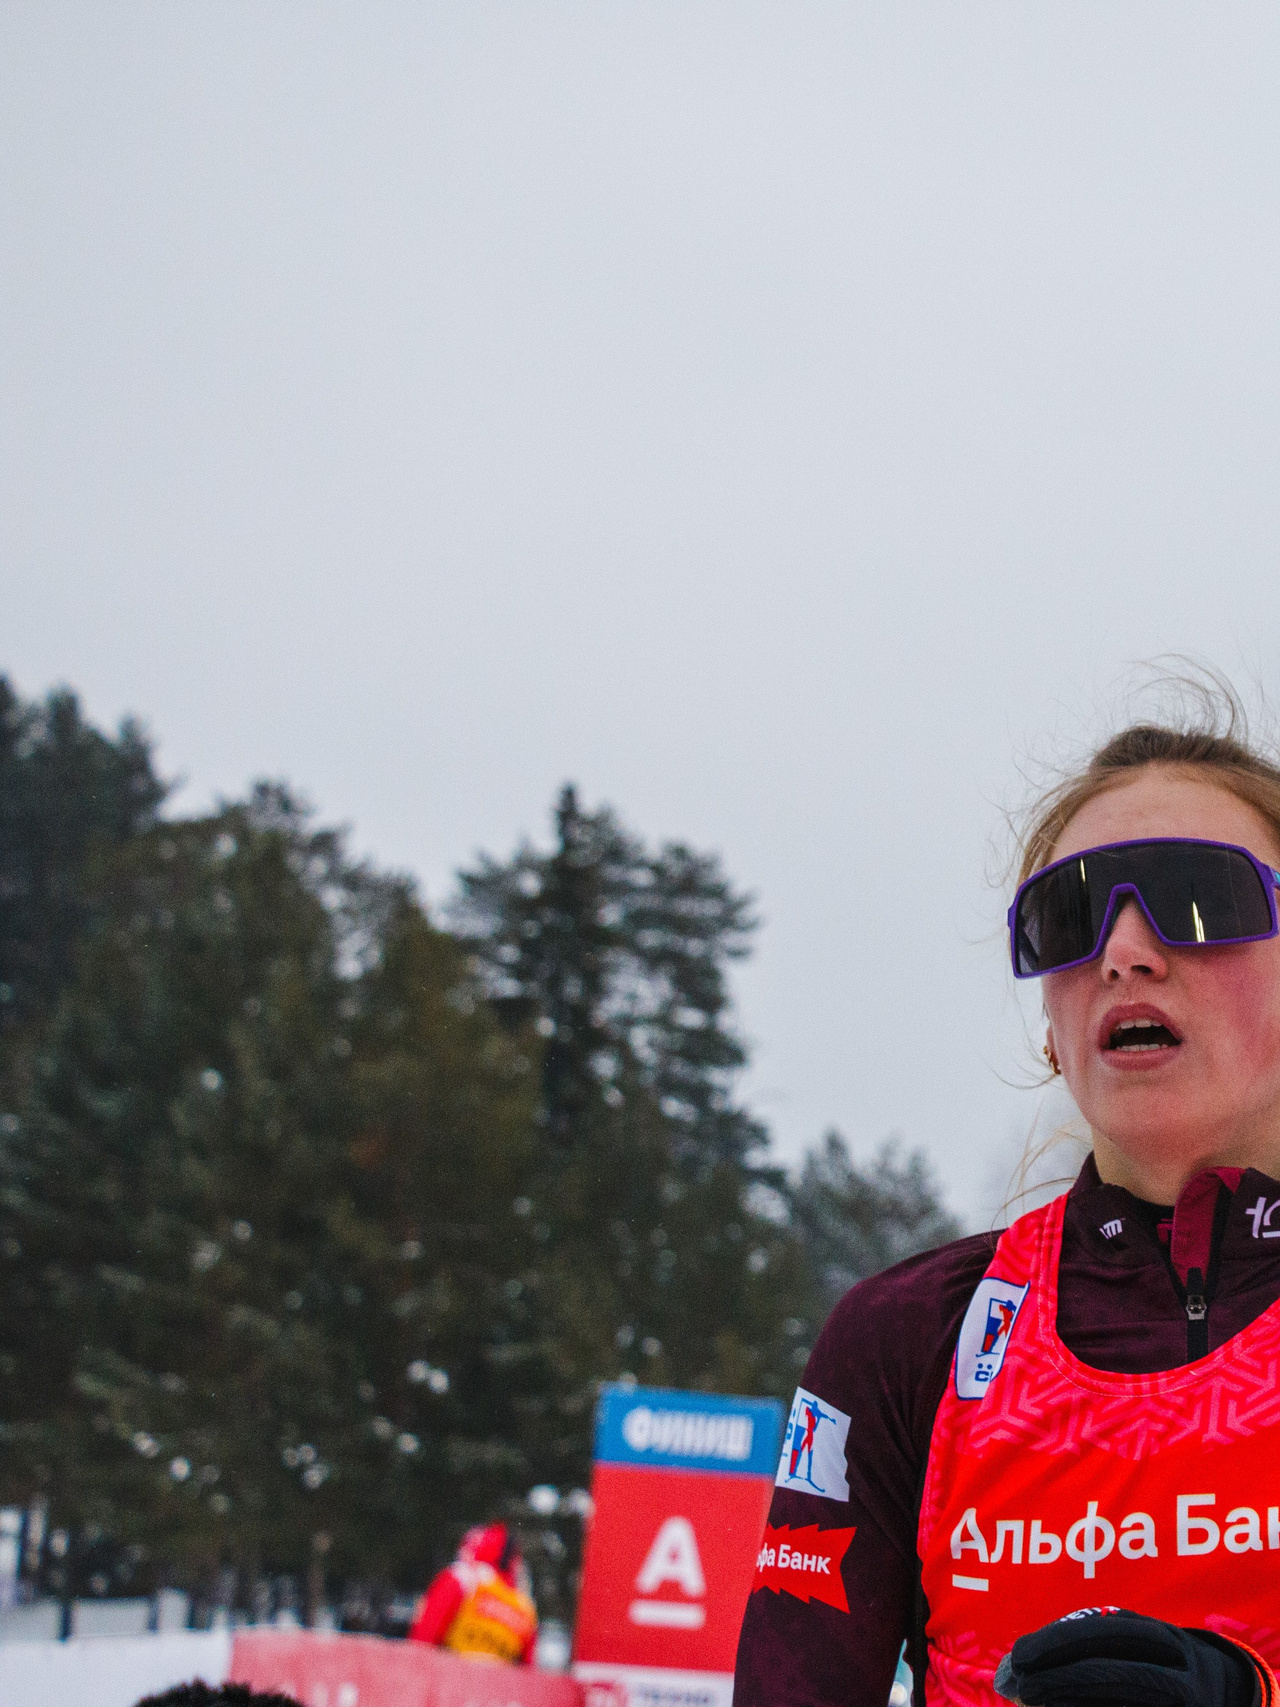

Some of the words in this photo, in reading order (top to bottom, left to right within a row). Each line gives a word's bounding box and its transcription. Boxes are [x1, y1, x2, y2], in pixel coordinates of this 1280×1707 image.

[622, 1406, 754, 1461] ФИНИШ
[777, 1543, 832, 1575] Банк
[950, 1500, 1159, 1580] Альфа
